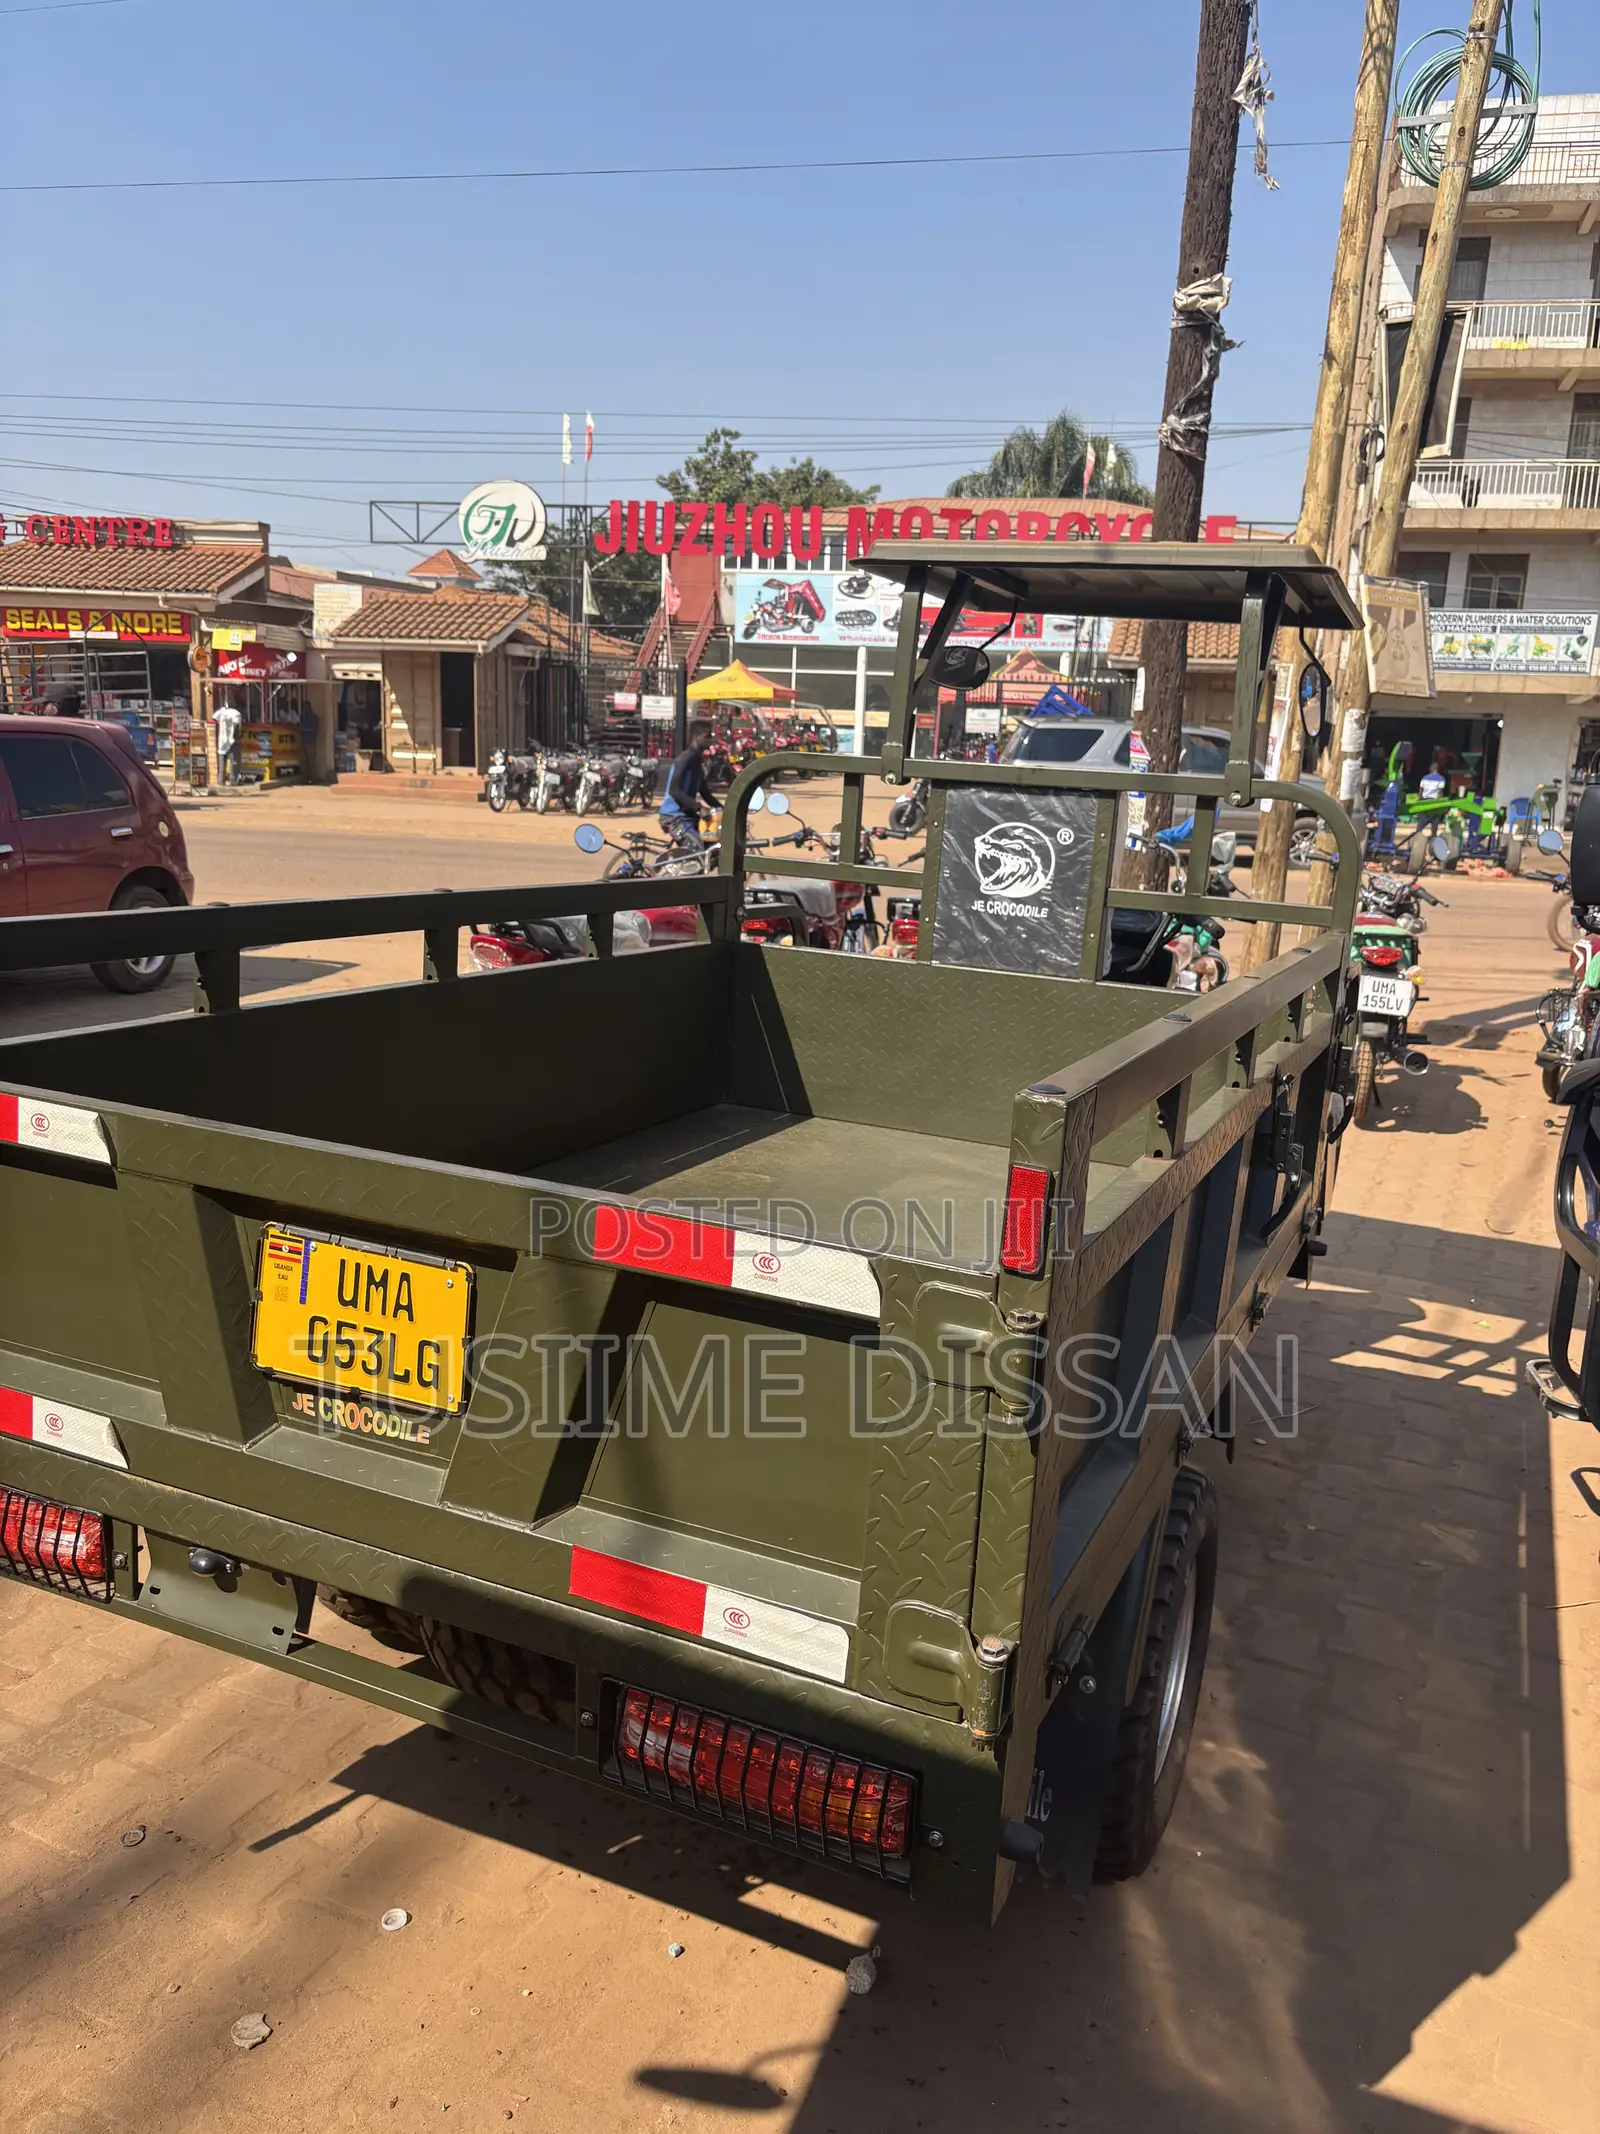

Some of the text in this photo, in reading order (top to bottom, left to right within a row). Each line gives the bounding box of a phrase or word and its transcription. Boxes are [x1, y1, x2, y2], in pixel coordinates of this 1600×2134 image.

[24, 514, 174, 548] CENTRE
[594, 499, 822, 562] JIUZHOU
[5, 608, 183, 635] SEALS & MORE
[1430, 613, 1592, 626] MODERN PLUMBERS & WATER SOLUTIONS
[971, 900, 1049, 918] JE CROCODILE
[1372, 980, 1396, 996] UMA
[1362, 994, 1404, 1011] 155LV
[274, 1262, 294, 1272] UGANDA
[337, 1258, 415, 1322] UMA
[307, 1315, 441, 1390] 053LG
[291, 1393, 431, 1445] JE CROCODILE
